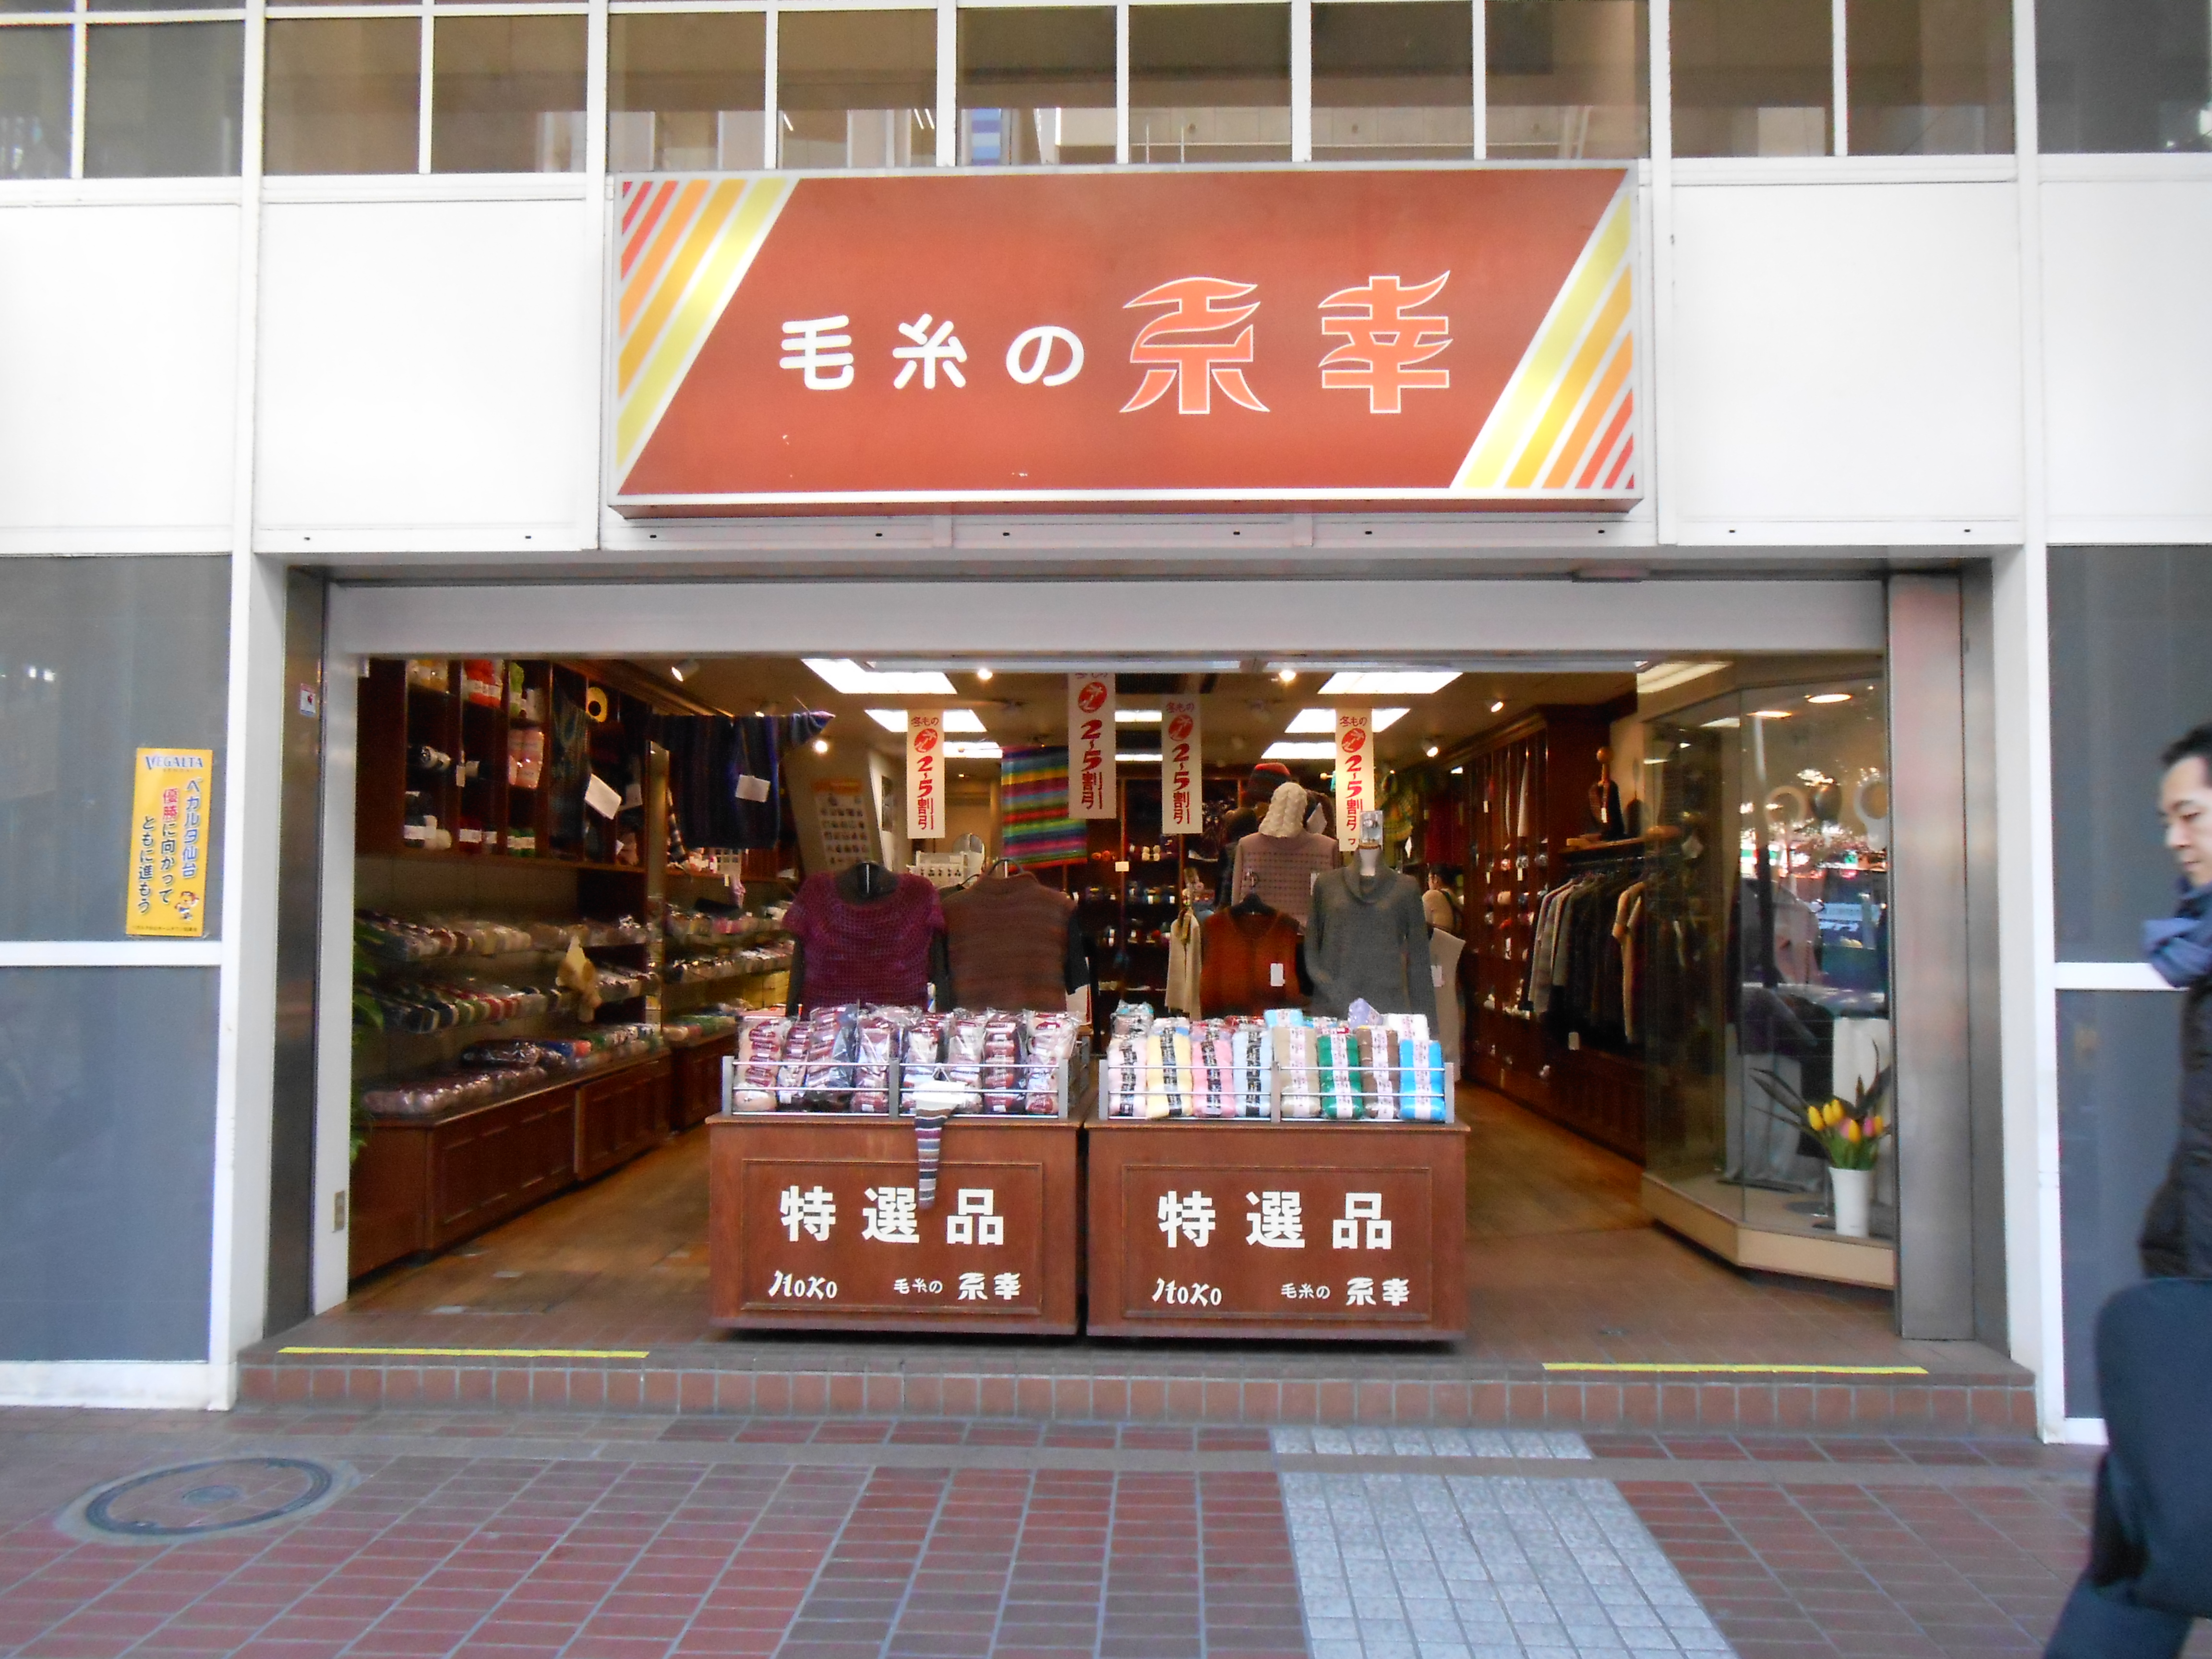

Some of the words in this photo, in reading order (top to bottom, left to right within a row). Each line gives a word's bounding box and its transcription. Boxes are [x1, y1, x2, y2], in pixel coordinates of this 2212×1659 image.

[145, 756, 204, 770] VEGALTA
[138, 816, 156, 914] ともに進もう
[780, 1186, 1003, 1245] 特選品
[1157, 1191, 1392, 1250] 特選品
